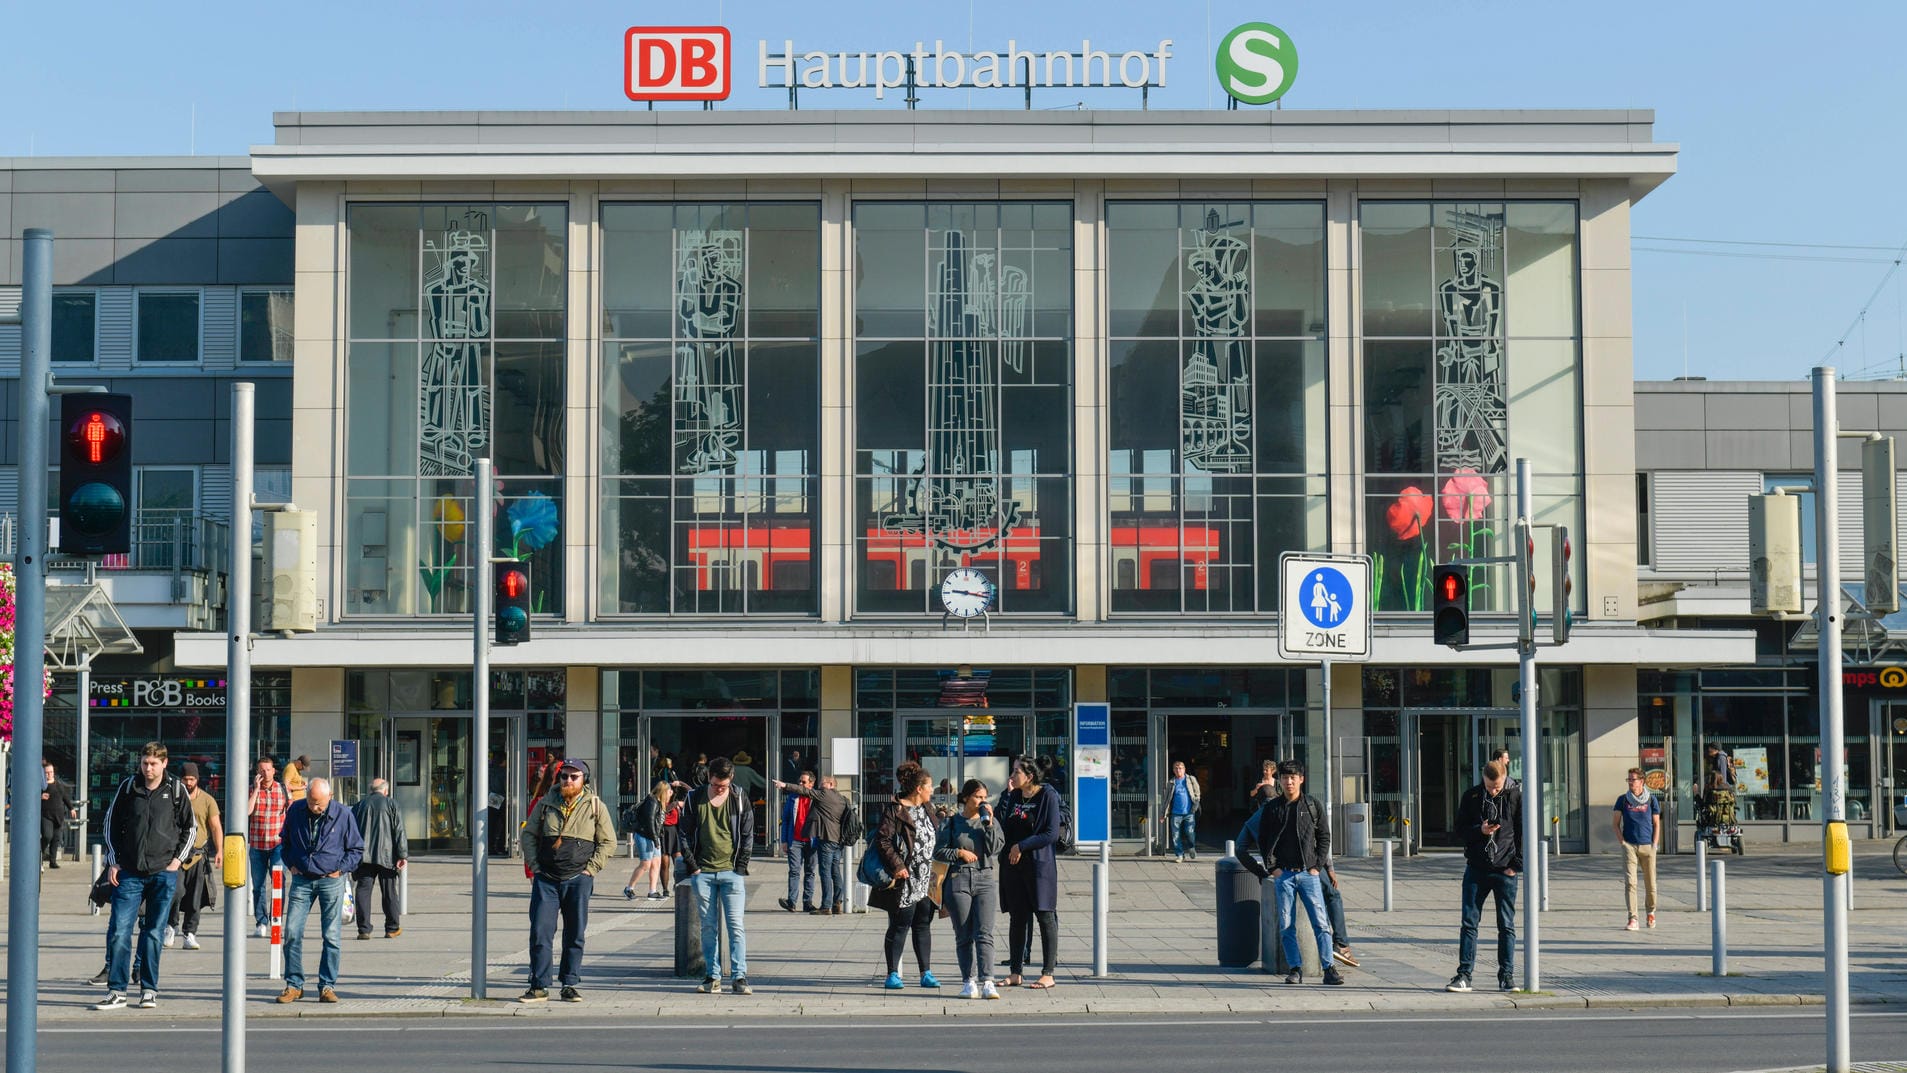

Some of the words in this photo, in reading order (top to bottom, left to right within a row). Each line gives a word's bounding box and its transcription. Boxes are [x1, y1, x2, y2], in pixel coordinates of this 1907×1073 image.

[638, 38, 718, 88] DB
[758, 39, 1173, 100] Hauptbahnhof
[1229, 29, 1284, 97] S
[1020, 560, 1027, 572] 2
[1305, 631, 1346, 648] ZONE
[90, 680, 123, 693] Press
[133, 679, 182, 706] P&B
[186, 693, 226, 706] Books
